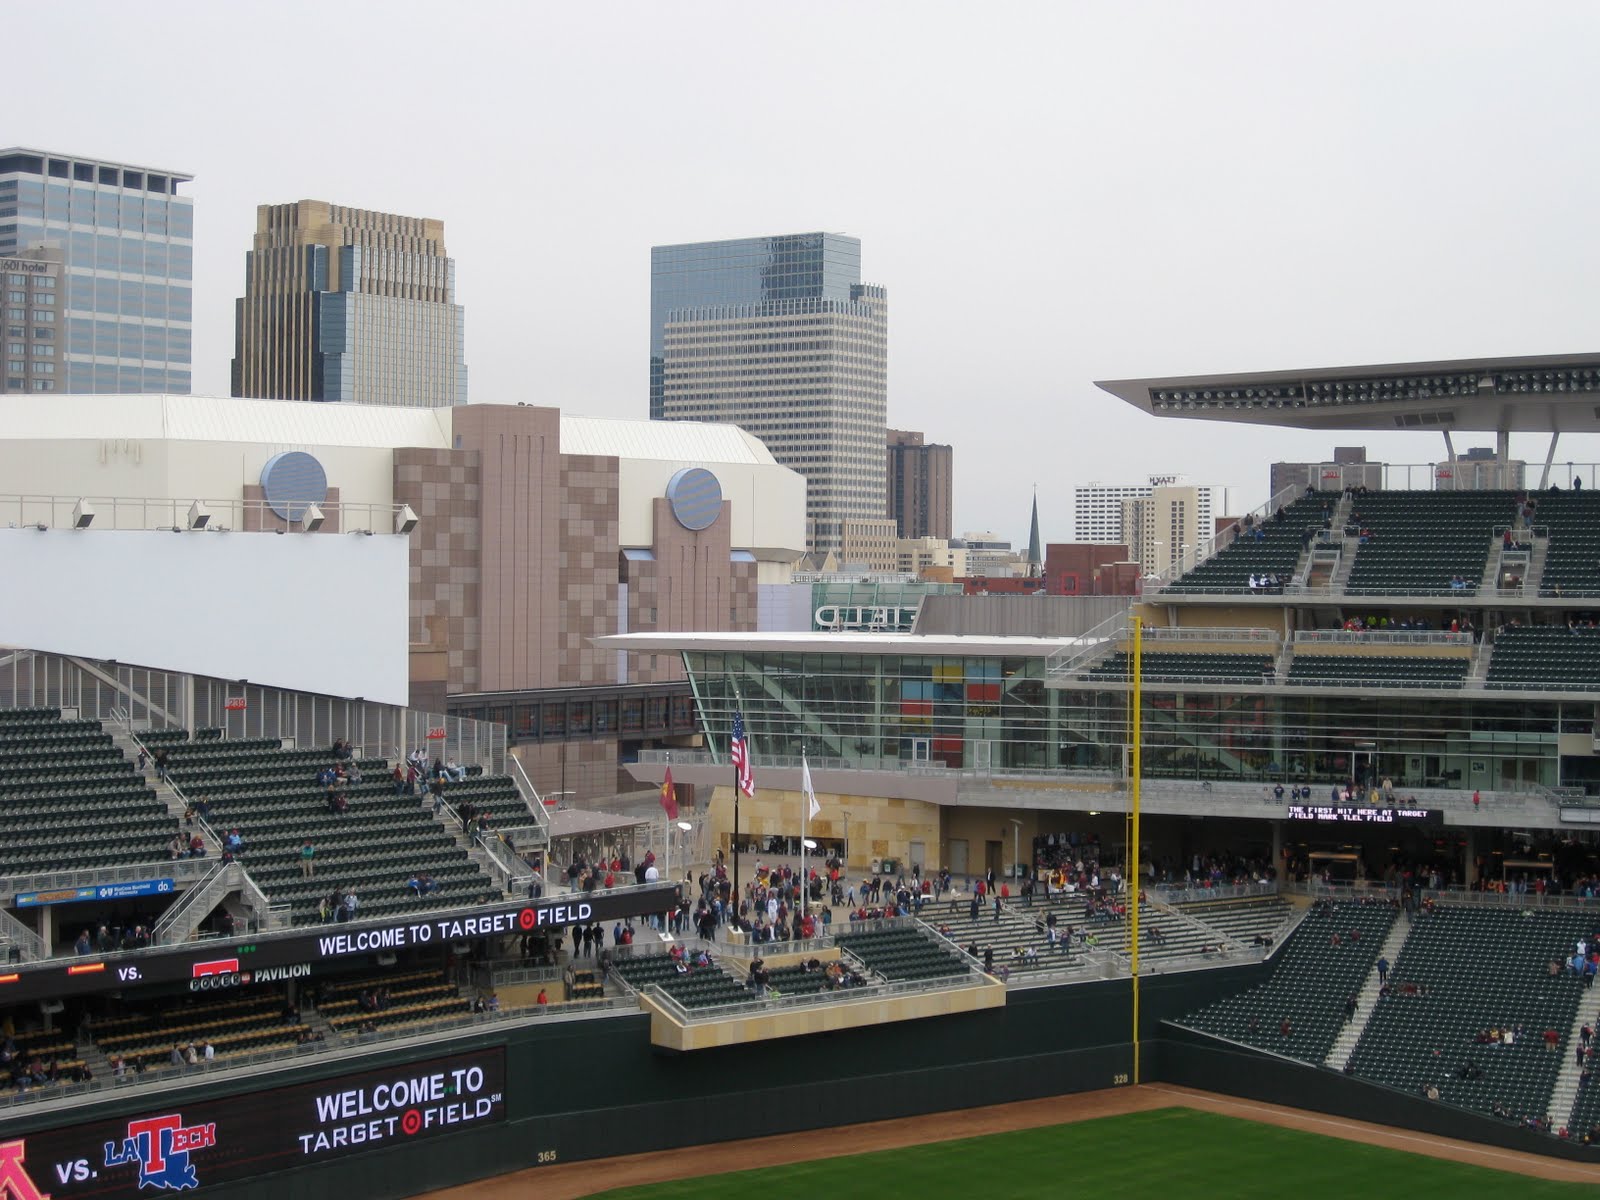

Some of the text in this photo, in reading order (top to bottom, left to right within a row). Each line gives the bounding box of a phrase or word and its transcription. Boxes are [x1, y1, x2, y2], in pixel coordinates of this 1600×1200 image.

[22, 261, 48, 273] hotel
[1149, 476, 1176, 485] HYATT
[229, 699, 246, 707] 239
[429, 728, 445, 737] 240
[1288, 812, 1314, 820] FIELD
[320, 903, 592, 956] WELCOME TO TARGET FIELD
[254, 963, 311, 983] PAVILION
[1114, 1074, 1128, 1084] 328
[316, 1066, 484, 1123] WELCOME TO
[298, 1116, 399, 1154] TARGET
[424, 1098, 492, 1129] FIELD
[104, 1139, 140, 1167] LA
[537, 1150, 557, 1163] 365
